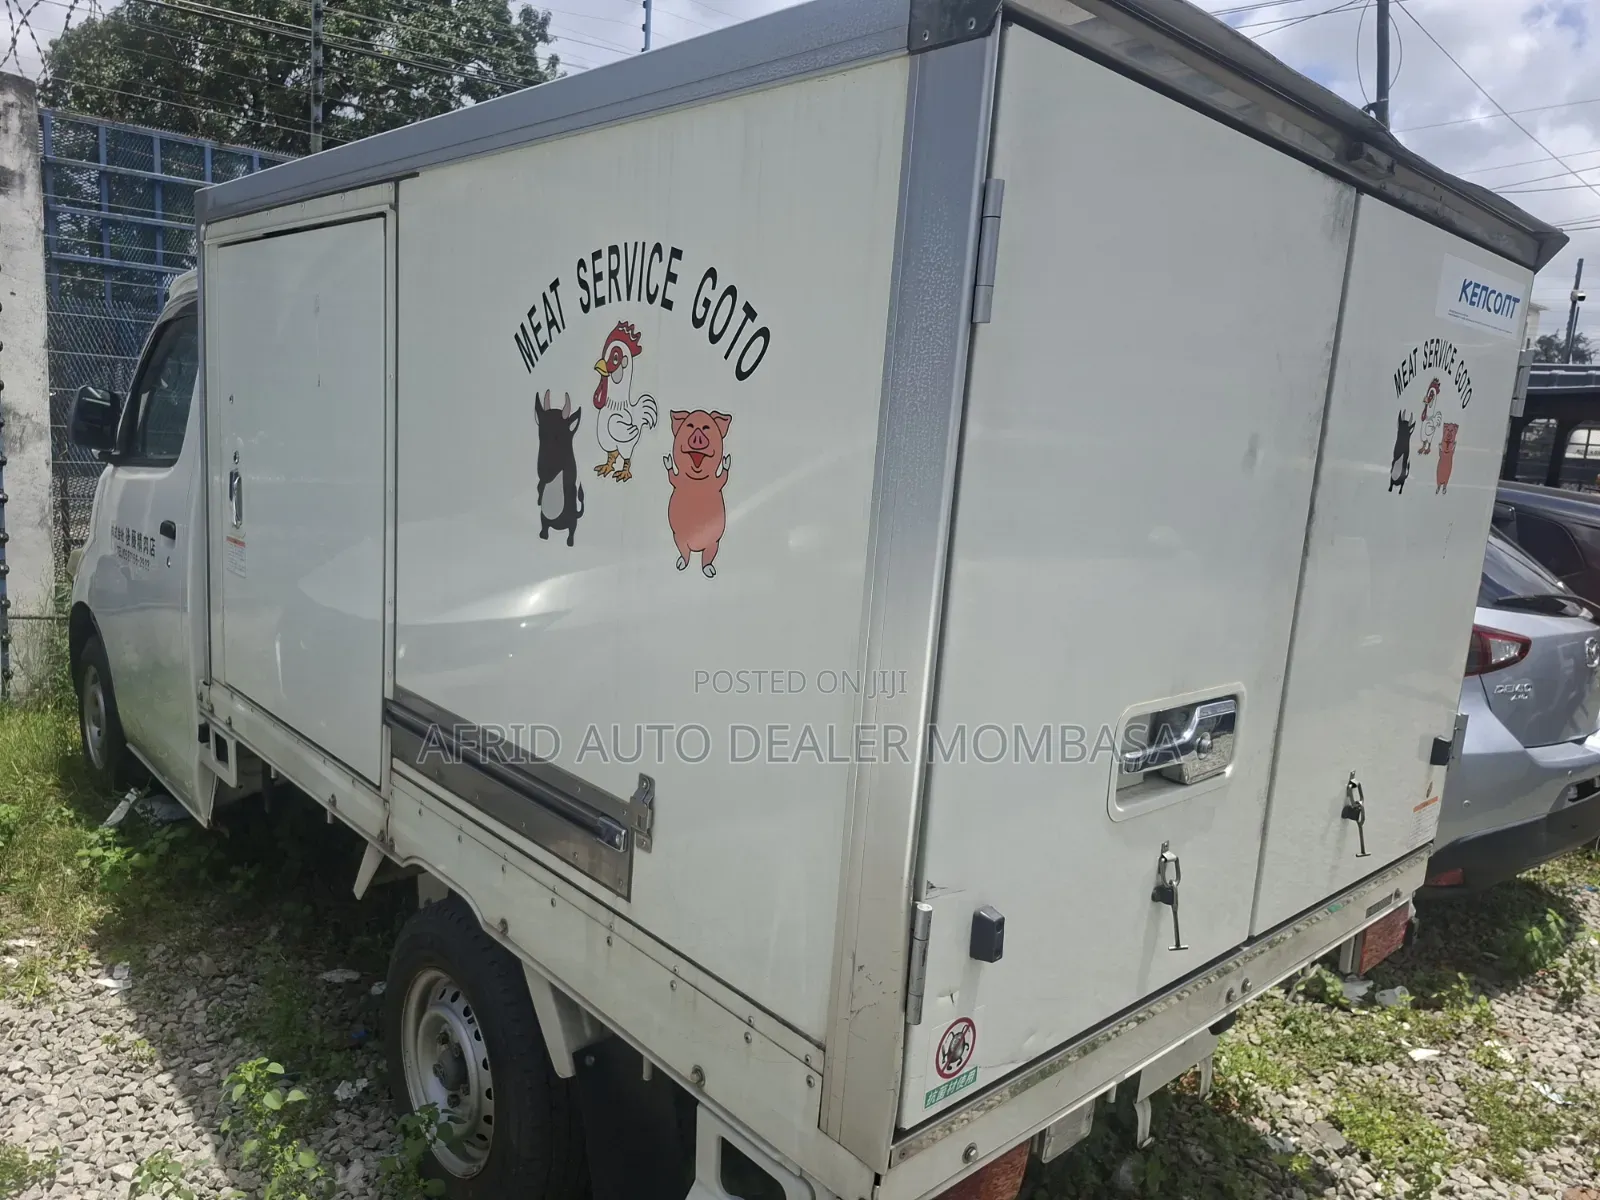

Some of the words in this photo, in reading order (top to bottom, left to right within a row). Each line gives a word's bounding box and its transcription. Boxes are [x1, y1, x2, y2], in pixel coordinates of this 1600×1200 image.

[514, 277, 566, 374] MEAT
[576, 241, 683, 314] SERVICE
[691, 266, 771, 381] GOTO
[1393, 347, 1418, 399] MEAT
[1422, 338, 1458, 376] SERVICE
[1454, 360, 1473, 409] GOTO
